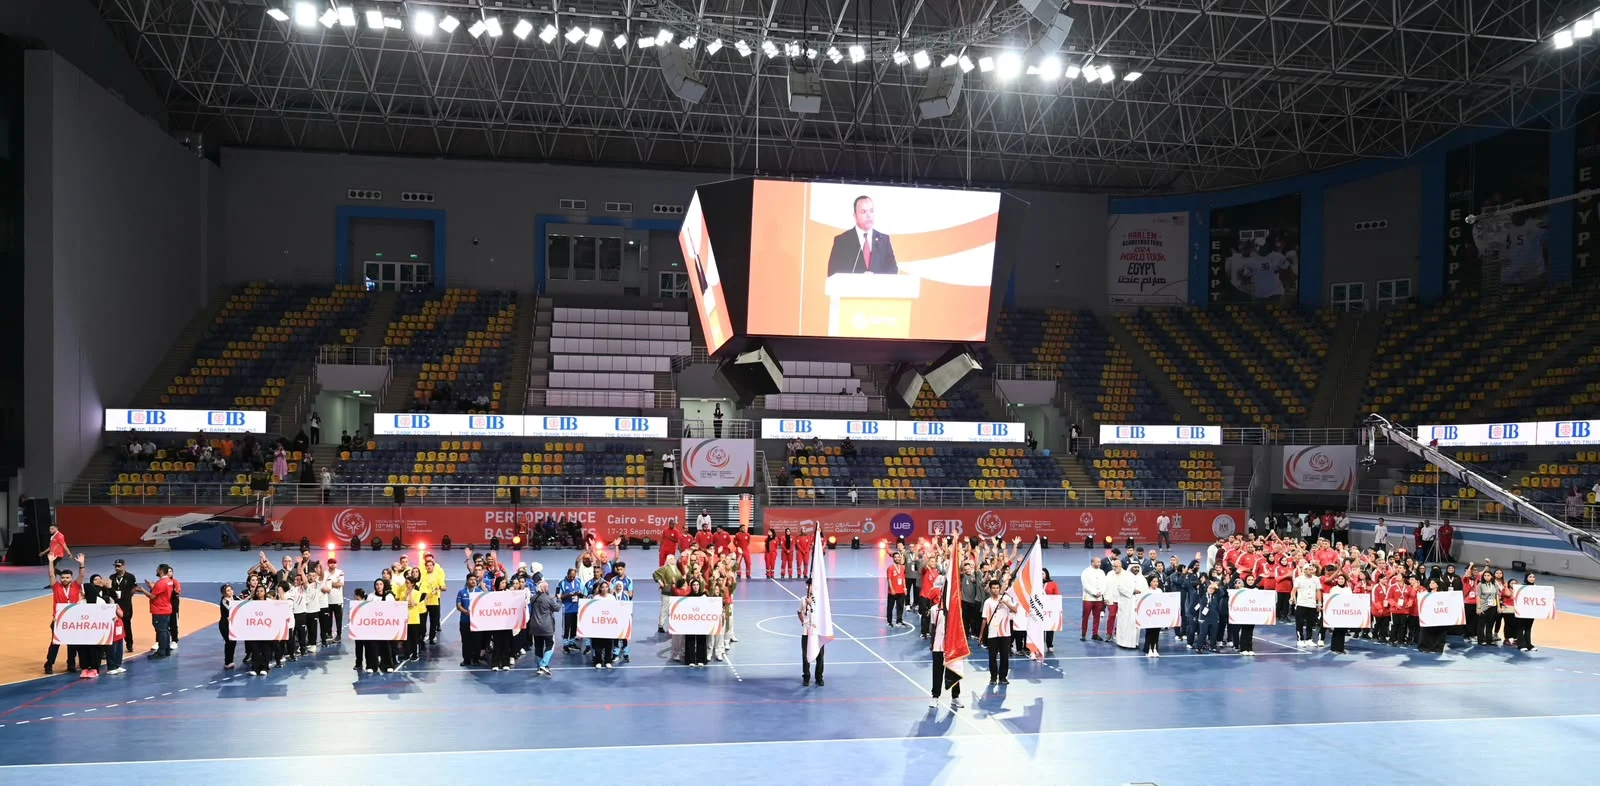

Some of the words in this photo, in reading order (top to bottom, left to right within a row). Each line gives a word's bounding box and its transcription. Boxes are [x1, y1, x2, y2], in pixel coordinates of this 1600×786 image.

[1128, 231, 1157, 239] HARLEM
[1448, 209, 1461, 289] EGYPT
[1120, 253, 1145, 261] WORLD
[1146, 253, 1166, 261] TOUR
[1127, 262, 1156, 275] EGYPT
[1210, 240, 1221, 301] EGYPT
[127, 410, 166, 425] CIB
[207, 411, 245, 425] CIB
[394, 415, 430, 428] CIB
[469, 415, 504, 429] CIB
[543, 416, 578, 430] CIB
[615, 417, 649, 431] CIB
[779, 420, 812, 433] CIB
[847, 421, 879, 434] CIB
[913, 422, 944, 435] CIB
[977, 423, 1008, 436] CIB
[1116, 426, 1145, 439] CIB
[1176, 426, 1205, 439] CIB
[1431, 426, 1458, 440] CIB
[1488, 424, 1519, 439] CIB
[1555, 421, 1591, 438] CIB
[607, 514, 636, 524] Cairo
[1523, 597, 1546, 606] RYLS
[479, 607, 518, 617] KUWAIT
[1145, 608, 1171, 616] QATAR
[61, 621, 110, 630] BAHRAIN
[246, 618, 272, 627] IRAQ
[357, 618, 400, 626] JORDAN
[591, 616, 618, 625] LIBYA
